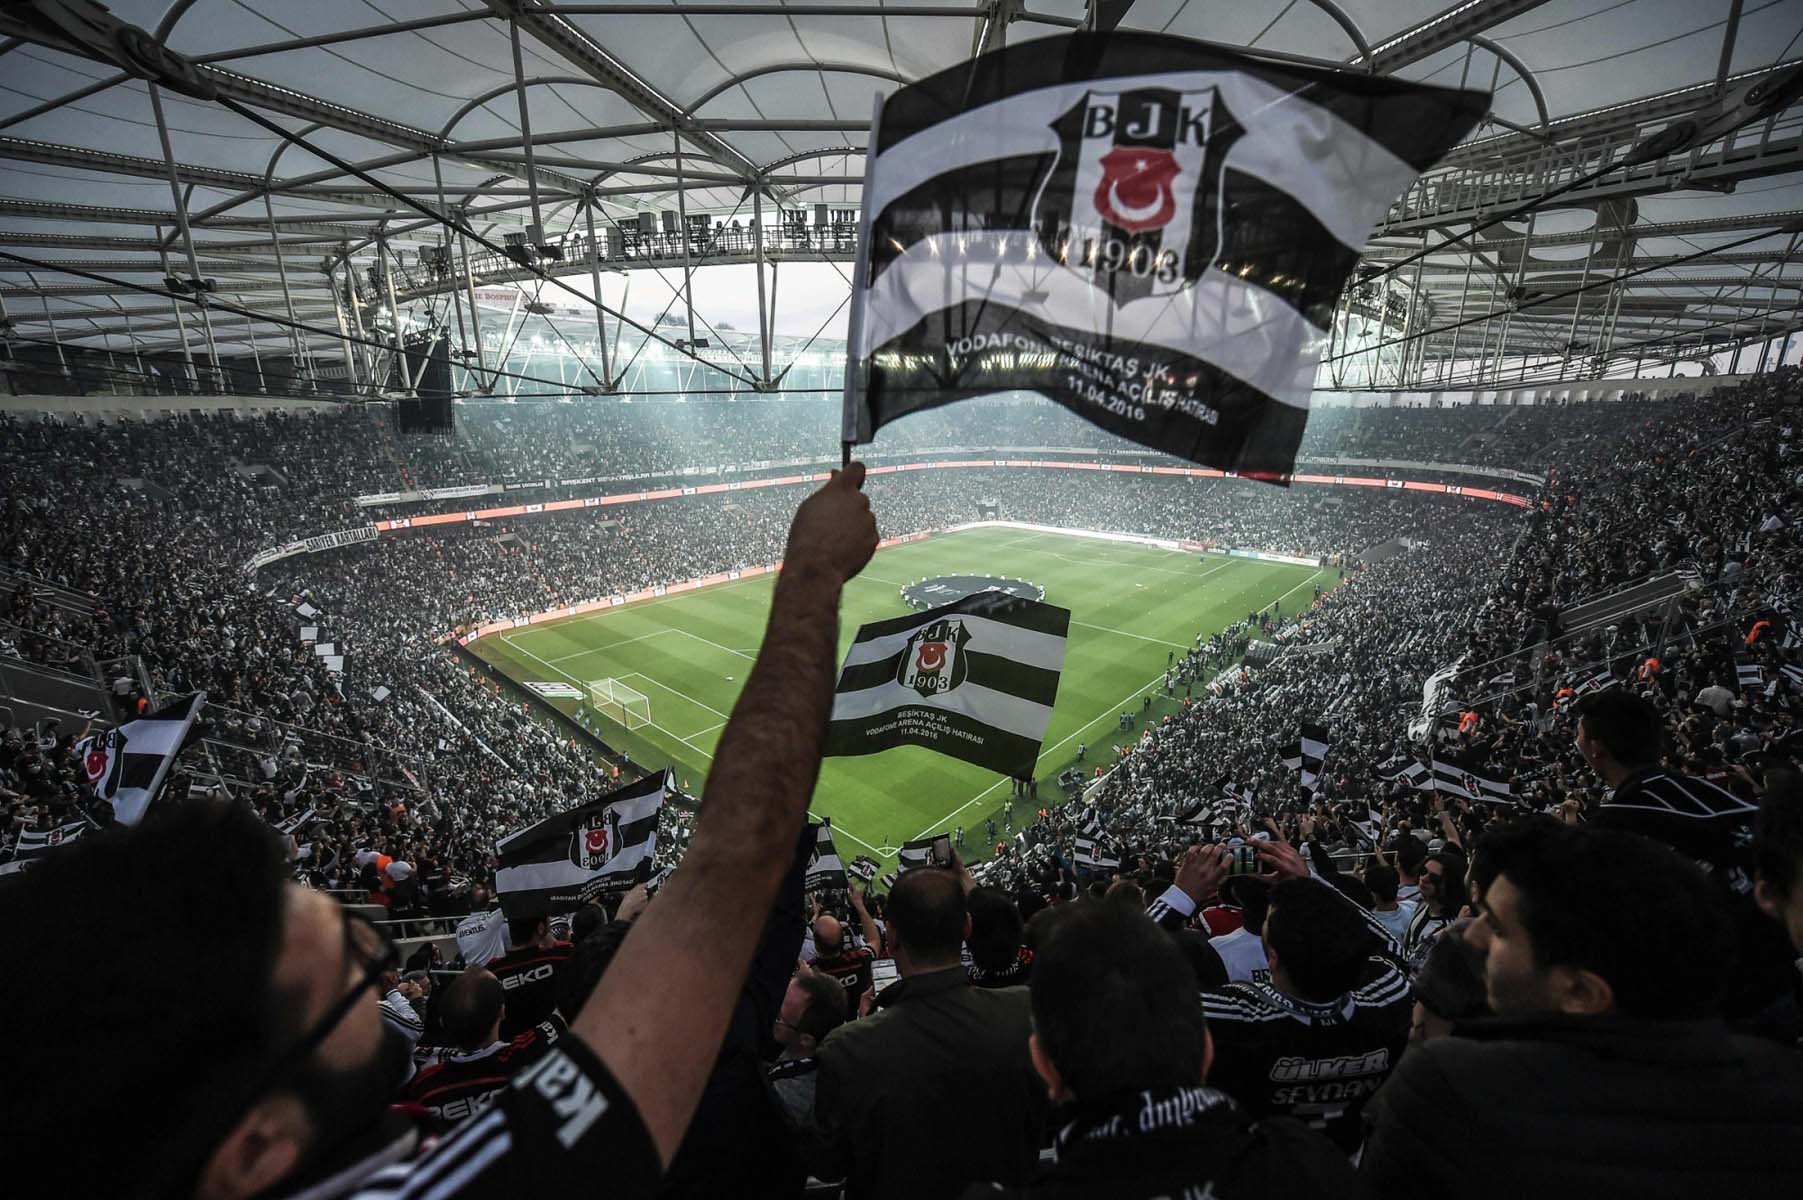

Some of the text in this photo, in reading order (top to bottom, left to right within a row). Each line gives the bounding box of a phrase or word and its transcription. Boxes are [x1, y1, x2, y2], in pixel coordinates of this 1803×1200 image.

[1078, 237, 1180, 284] 1903
[908, 674, 949, 690] 1903
[897, 709, 948, 723] BEŞİKTAŞ JK
[898, 718, 925, 728] ARENA
[952, 728, 984, 745] HATIRASI
[900, 727, 938, 740] 11.04.2016
[499, 964, 554, 990] EKO
[1270, 1047, 1390, 1083] ÜLKER
